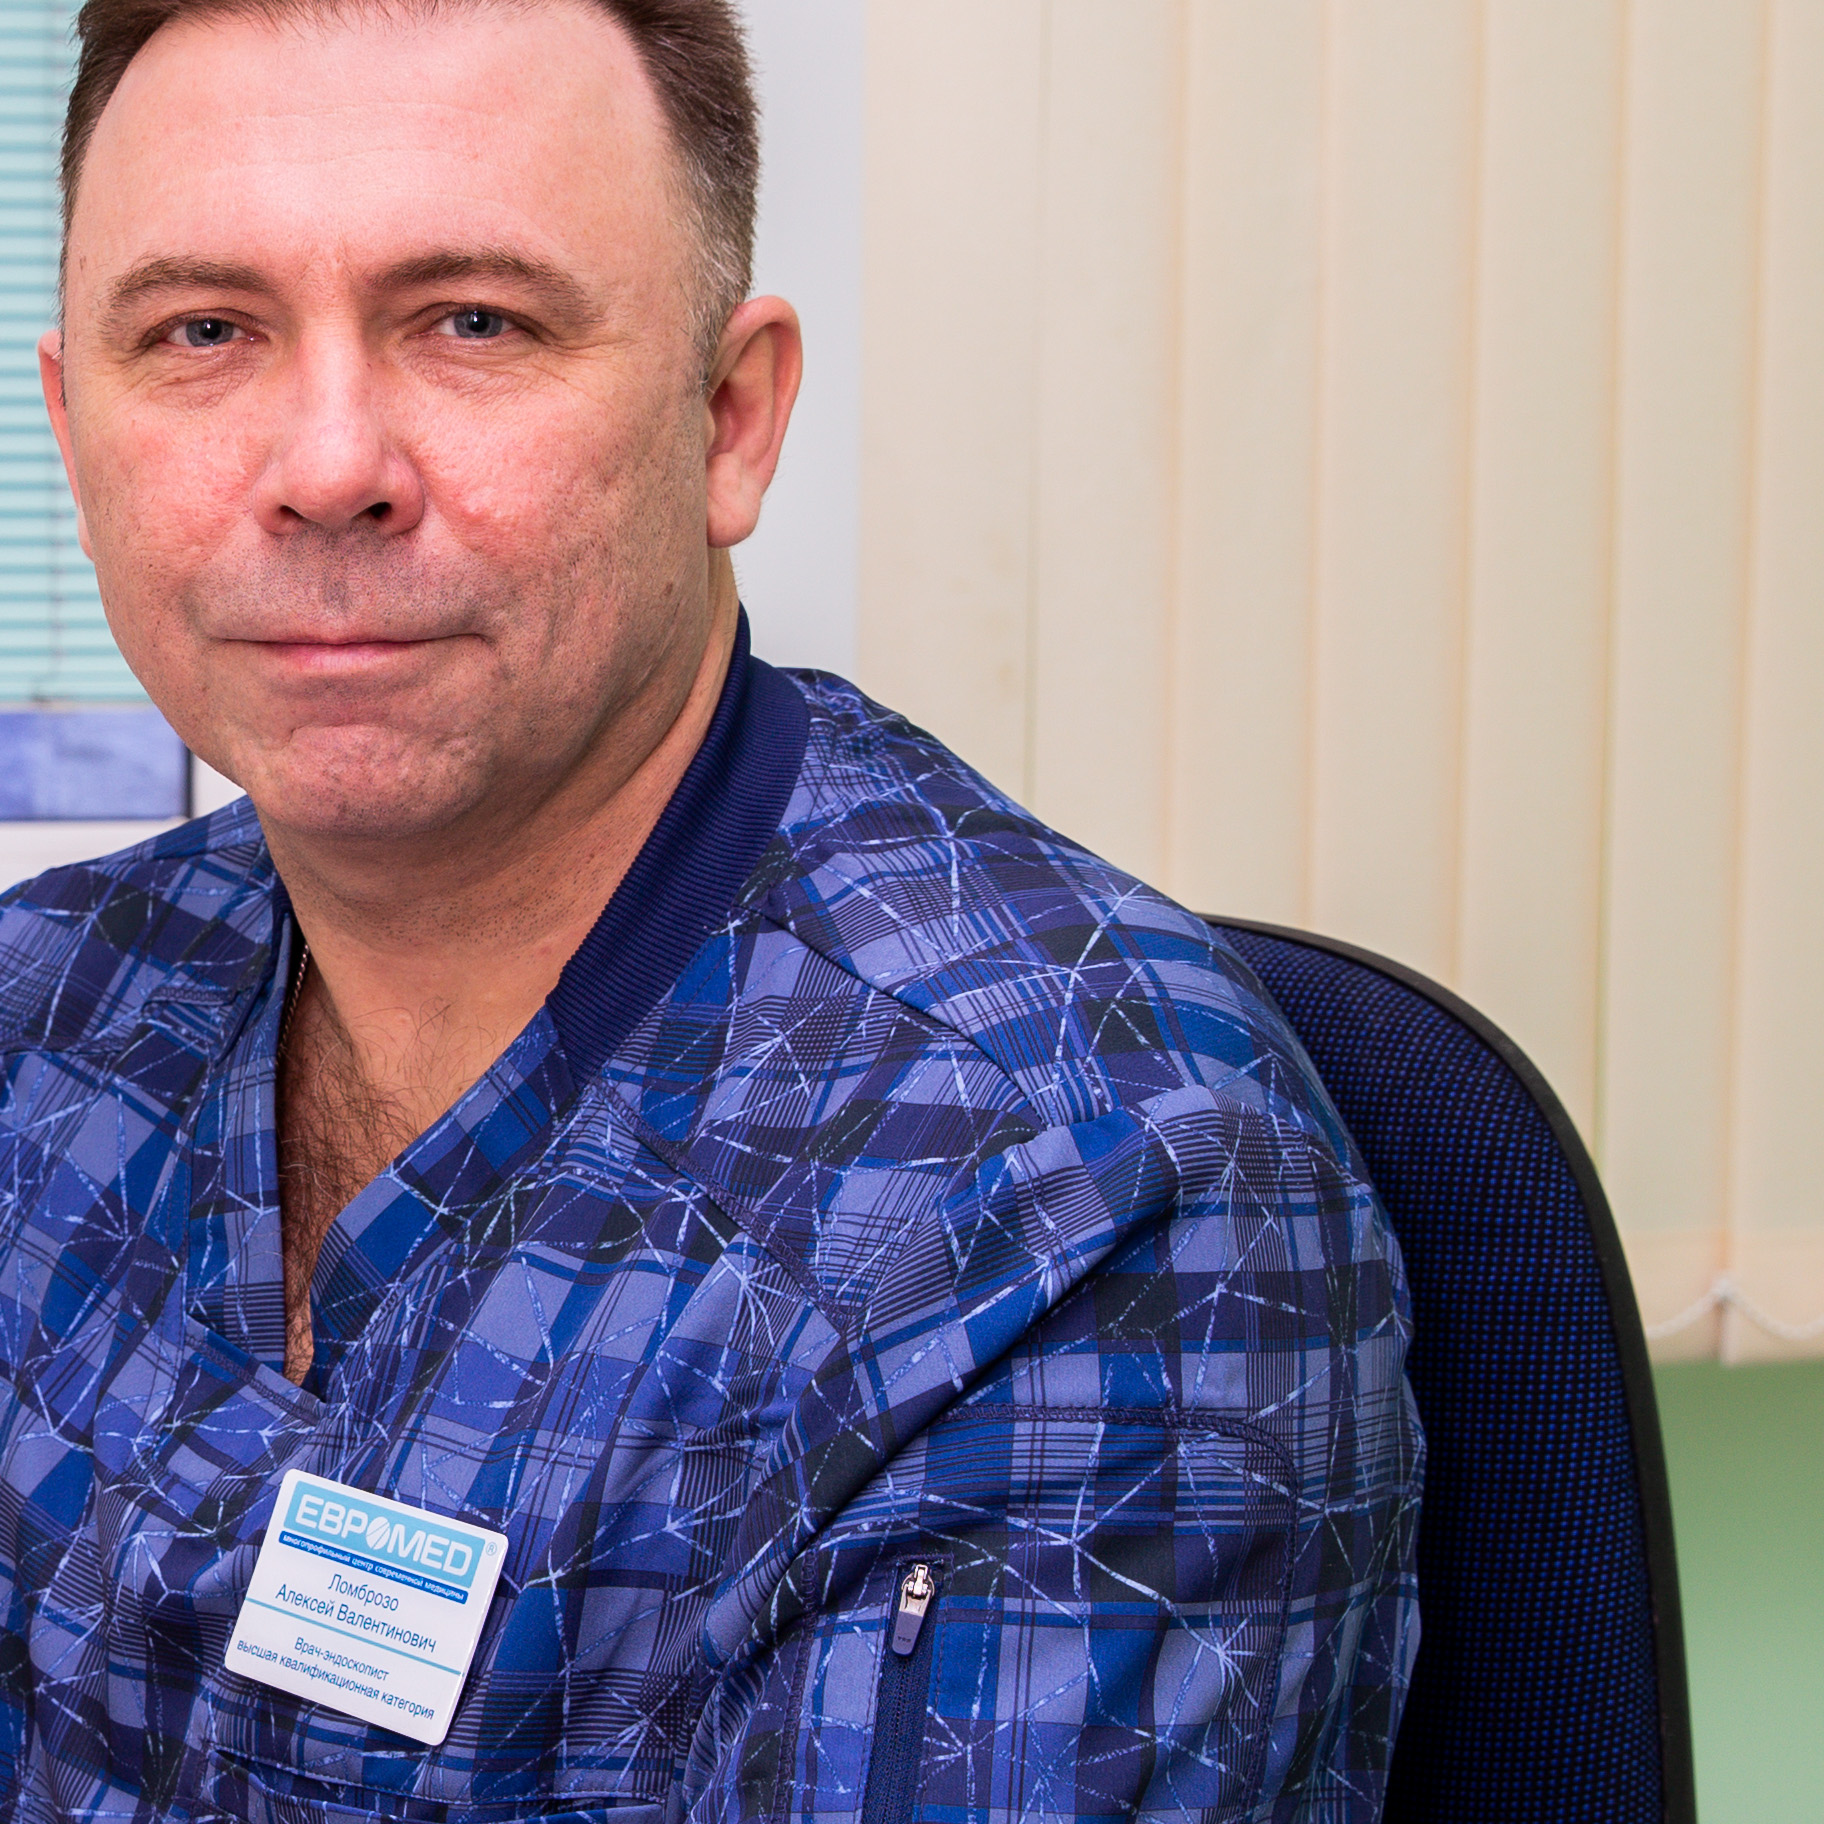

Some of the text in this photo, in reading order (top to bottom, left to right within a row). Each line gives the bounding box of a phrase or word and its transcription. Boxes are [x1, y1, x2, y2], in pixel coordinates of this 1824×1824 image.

[275, 1583, 437, 1654] Алексей Валентинович
[328, 1573, 399, 1612] Ломброзо
[237, 1639, 435, 1720] высшая квалификационная категория
[294, 1636, 390, 1681] Врач-эндоскопист
